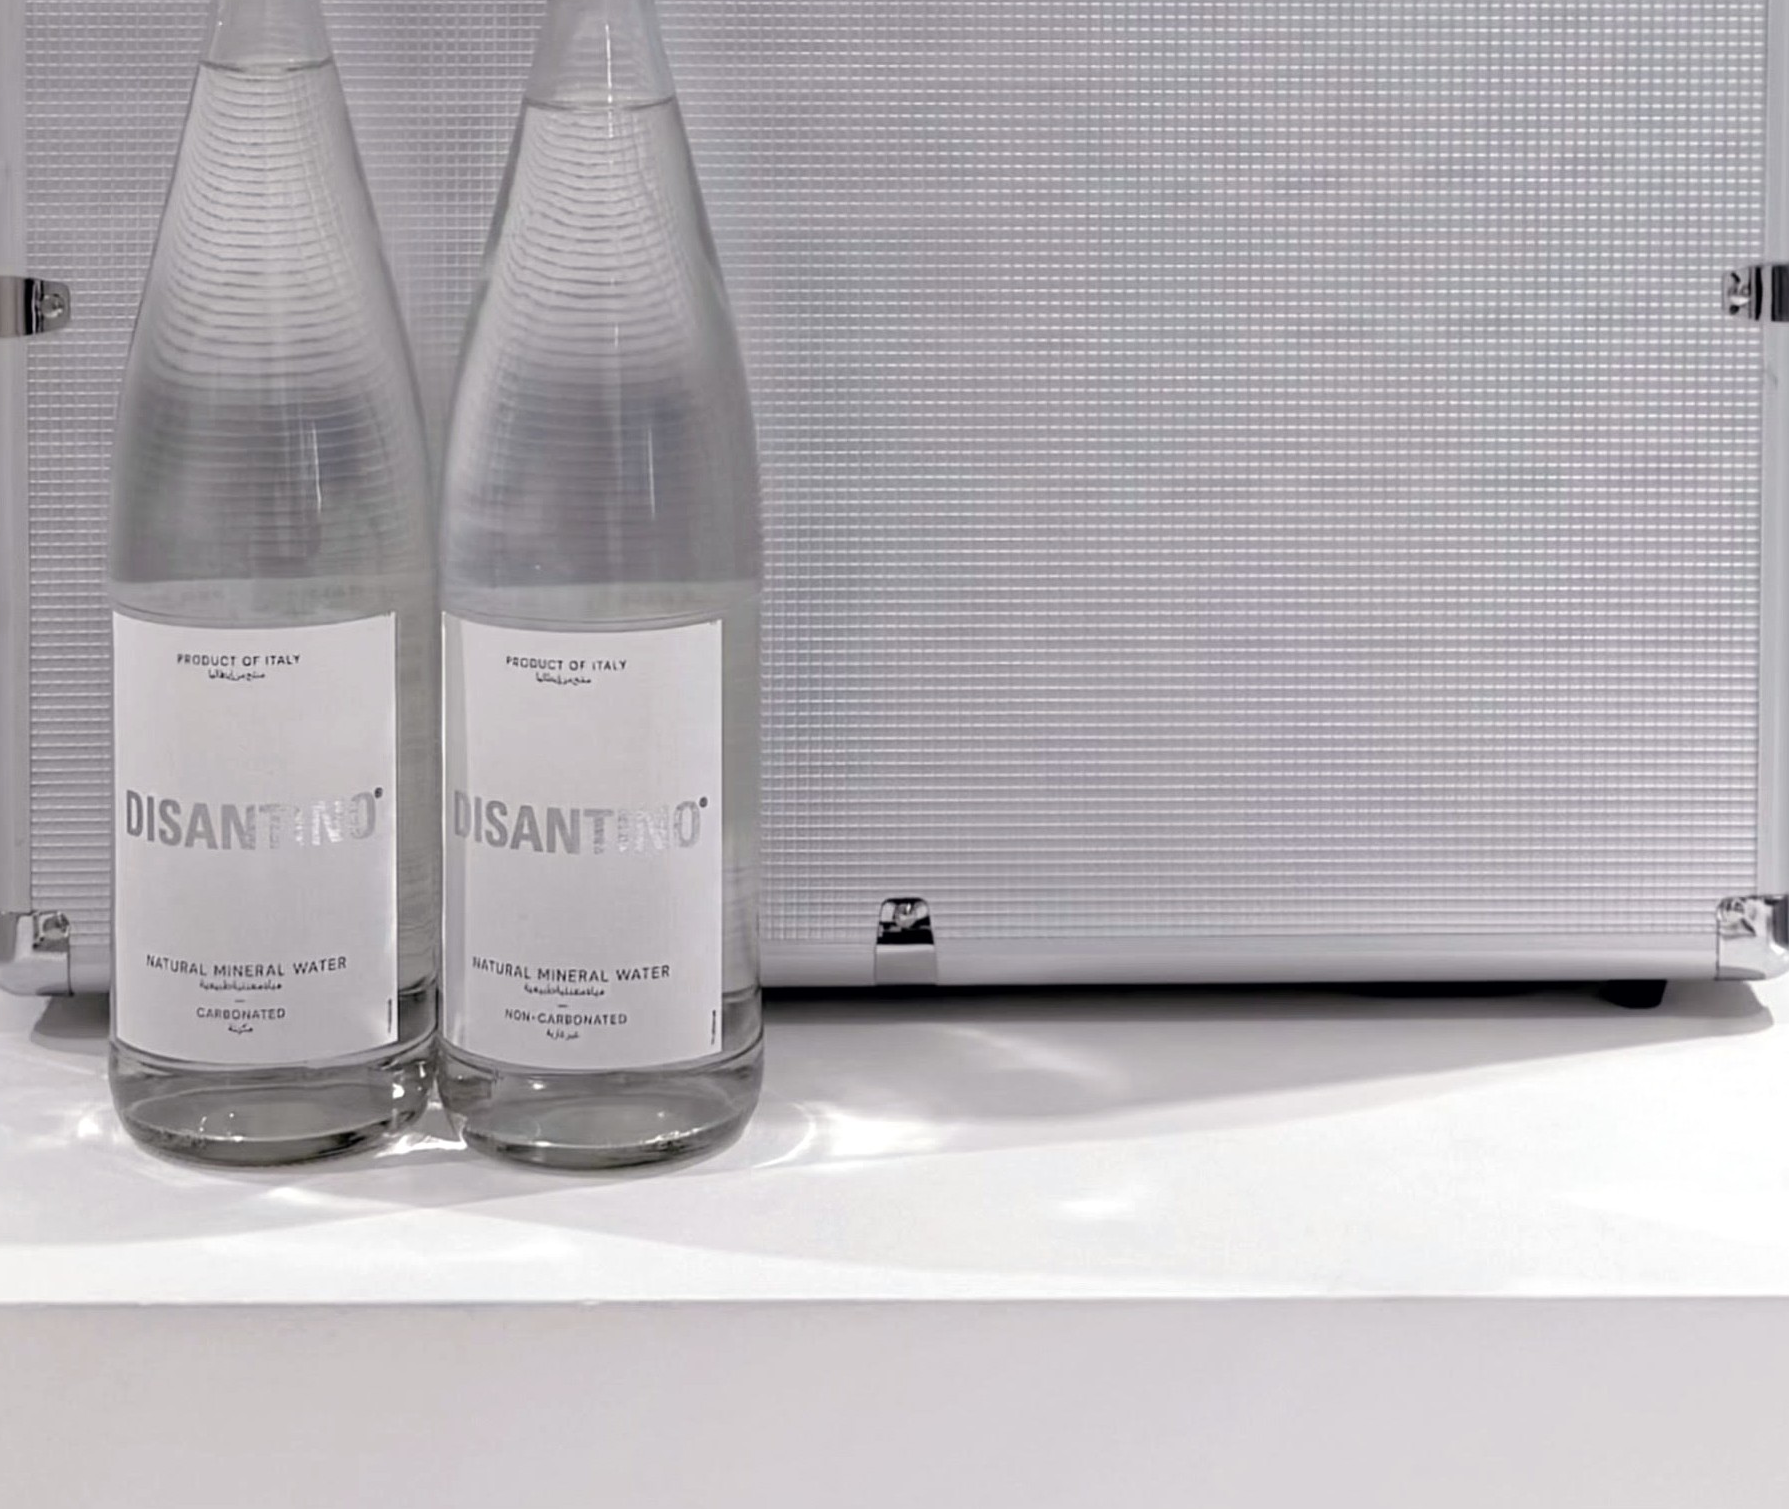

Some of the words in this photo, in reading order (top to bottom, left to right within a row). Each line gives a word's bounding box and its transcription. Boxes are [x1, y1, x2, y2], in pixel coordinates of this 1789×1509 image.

[176, 653, 236, 667] PRODUCT
[241, 655, 260, 667] OF
[264, 654, 300, 666] ITALY
[505, 655, 563, 671] PRODUCT
[568, 659, 586, 671] OF
[591, 659, 627, 671] ITALY
[146, 954, 208, 977] NATURAL
[213, 963, 286, 978] MINERAL
[292, 956, 347, 975] WATER
[472, 956, 532, 980] NATURAL
[537, 967, 609, 983] MINERAL
[615, 964, 671, 981] WATER
[196, 1006, 286, 1020] CARBONATED
[504, 1008, 628, 1026] NON-CARBONATED
